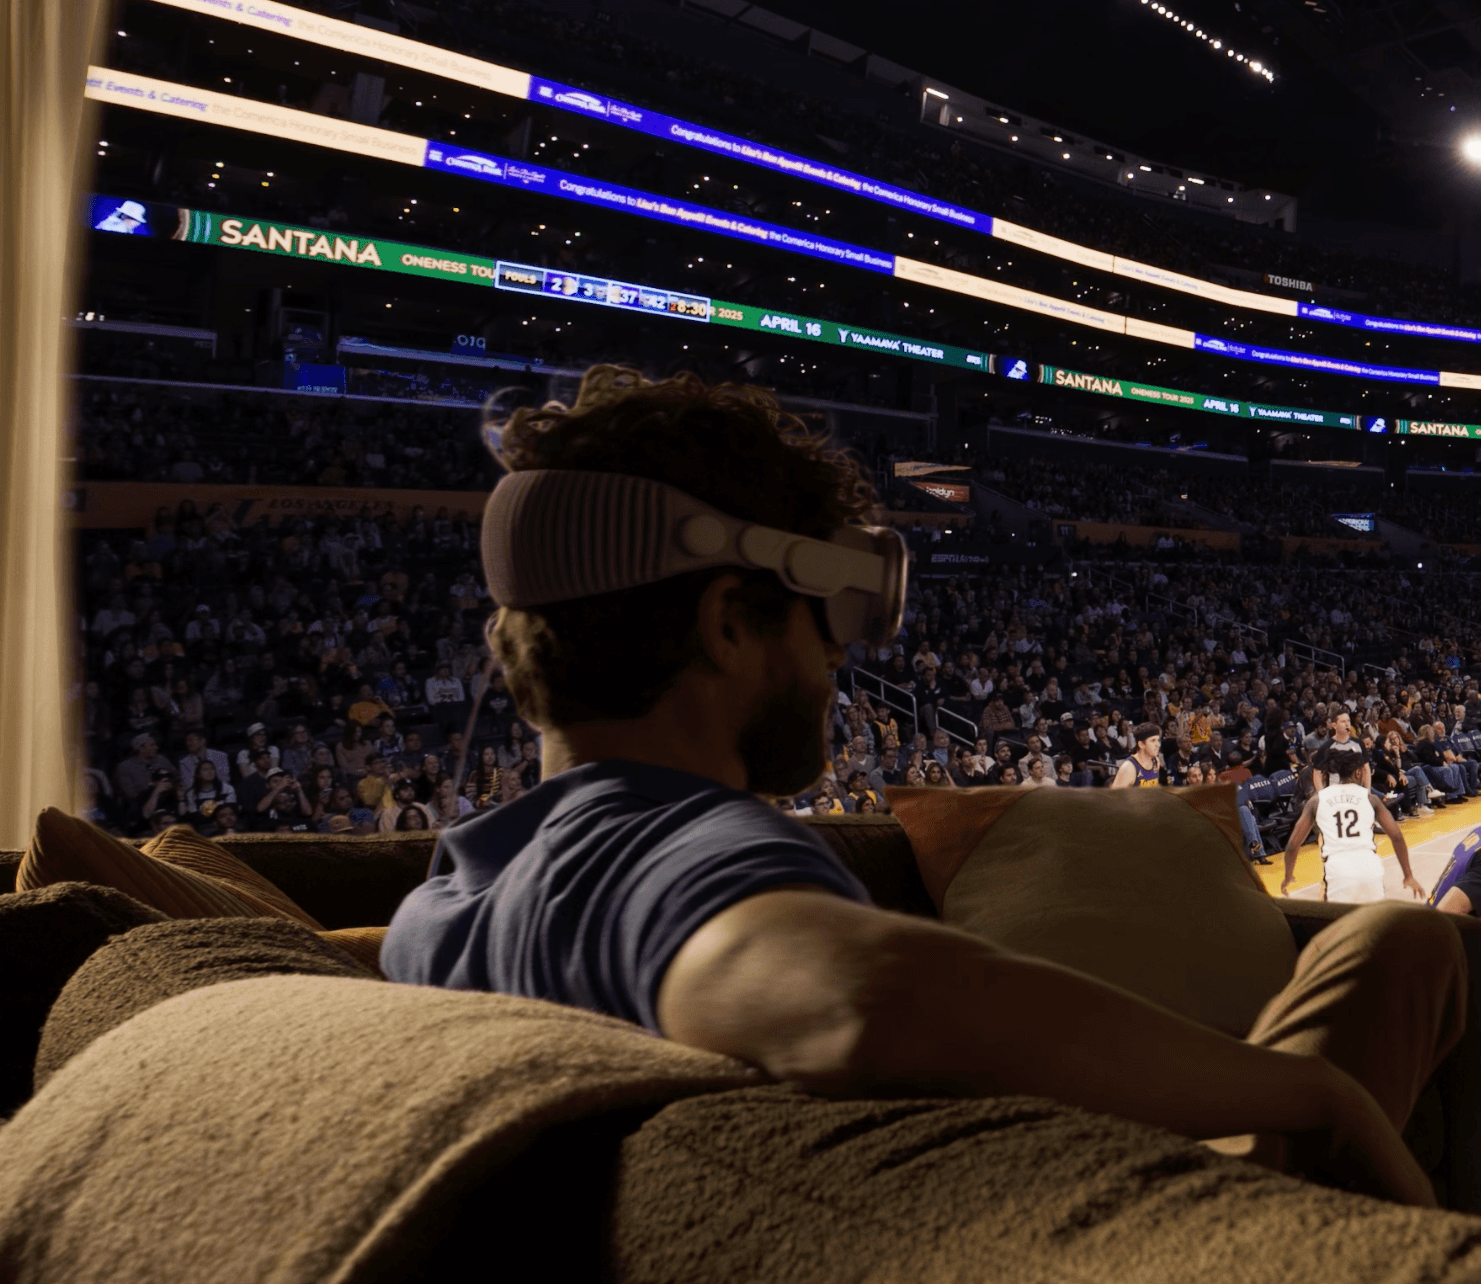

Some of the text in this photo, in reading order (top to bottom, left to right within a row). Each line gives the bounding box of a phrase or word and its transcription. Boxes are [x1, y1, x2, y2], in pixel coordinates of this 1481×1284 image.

[560, 180, 626, 203] Congratulations
[221, 220, 381, 265] SANTANA
[402, 254, 466, 273] ONENESS
[505, 270, 537, 285] FOULS
[551, 278, 562, 291] 2
[1268, 273, 1314, 292] TOSHIBA
[677, 300, 707, 317] 8:30
[718, 308, 743, 320] 2025
[761, 315, 801, 333] APRIL
[806, 323, 821, 336] 16
[903, 343, 943, 358] THEATER
[1056, 370, 1122, 395] SANTANA
[1204, 399, 1228, 411] APRIL
[1410, 422, 1469, 436] SANTANA
[1333, 809, 1360, 838] 12
